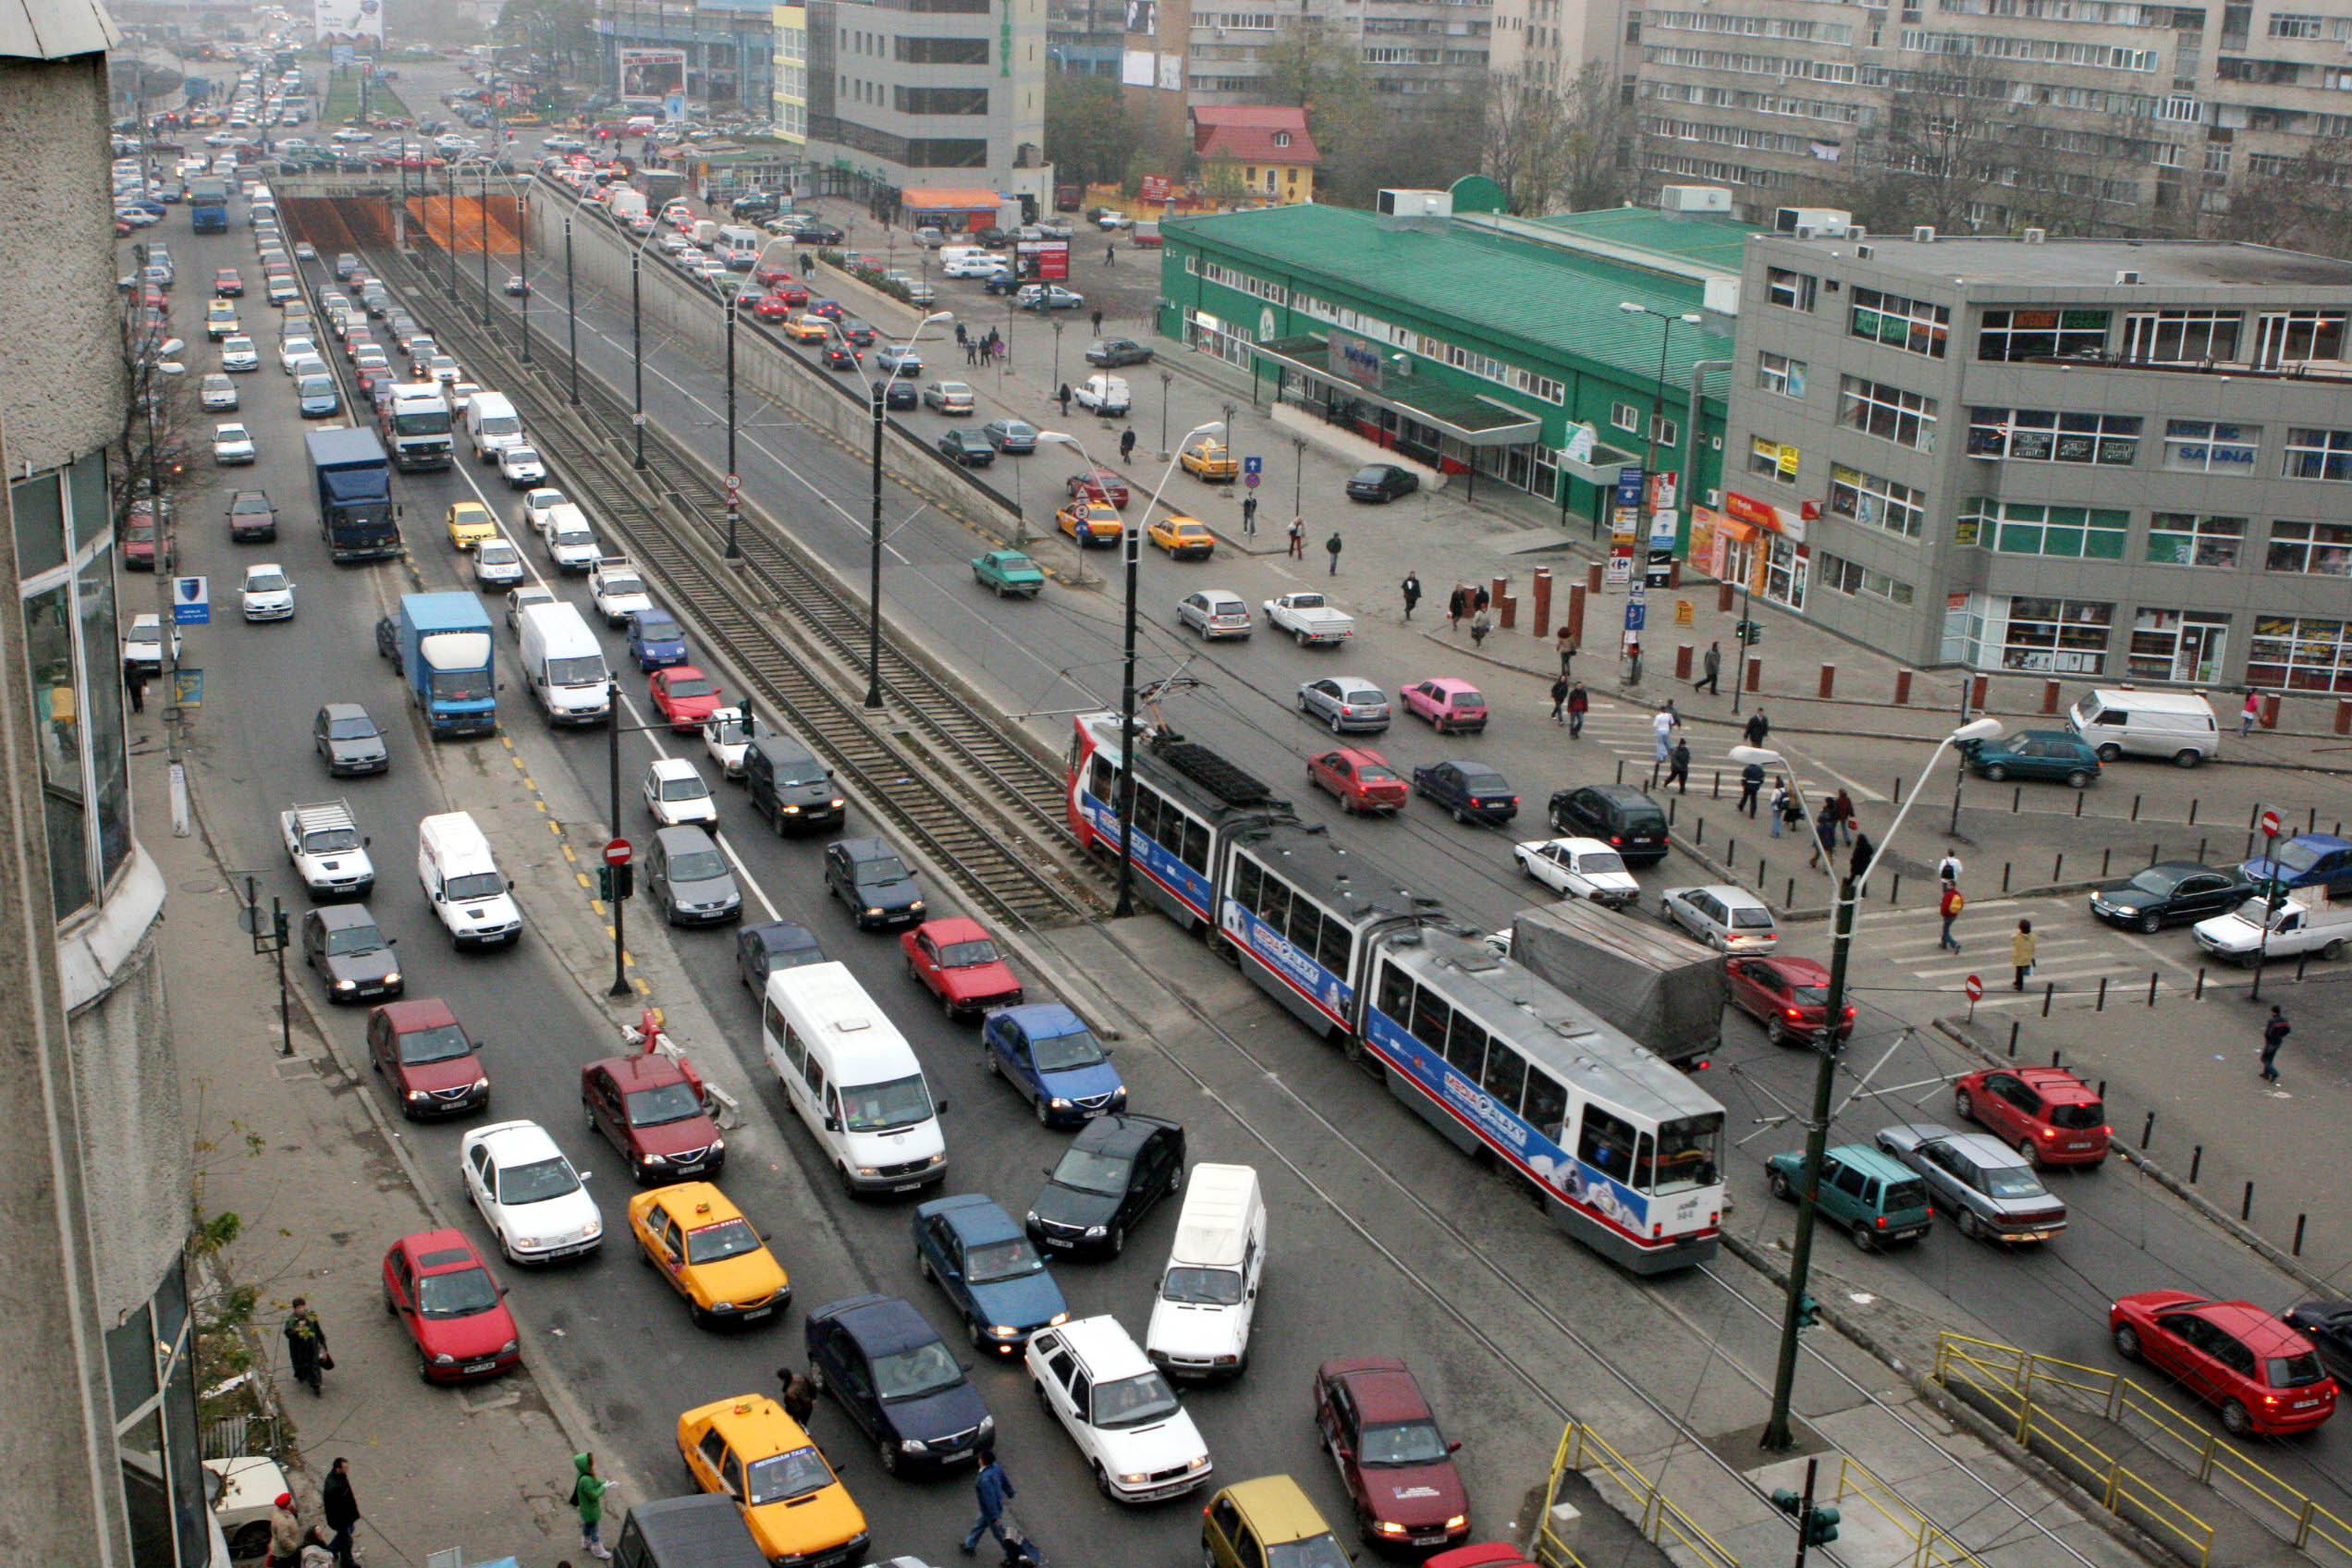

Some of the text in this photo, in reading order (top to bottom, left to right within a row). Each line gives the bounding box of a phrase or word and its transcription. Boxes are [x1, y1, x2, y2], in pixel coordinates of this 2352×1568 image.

[2179, 447, 2254, 463] SAUNA
[1254, 924, 1280, 953] MEDIA
[1280, 940, 1319, 985] GALAXY
[1444, 1072, 1478, 1107] MEDIA
[1478, 1095, 1526, 1146] GALAXY
[754, 1448, 807, 1468] MERIDIAN TAXI
